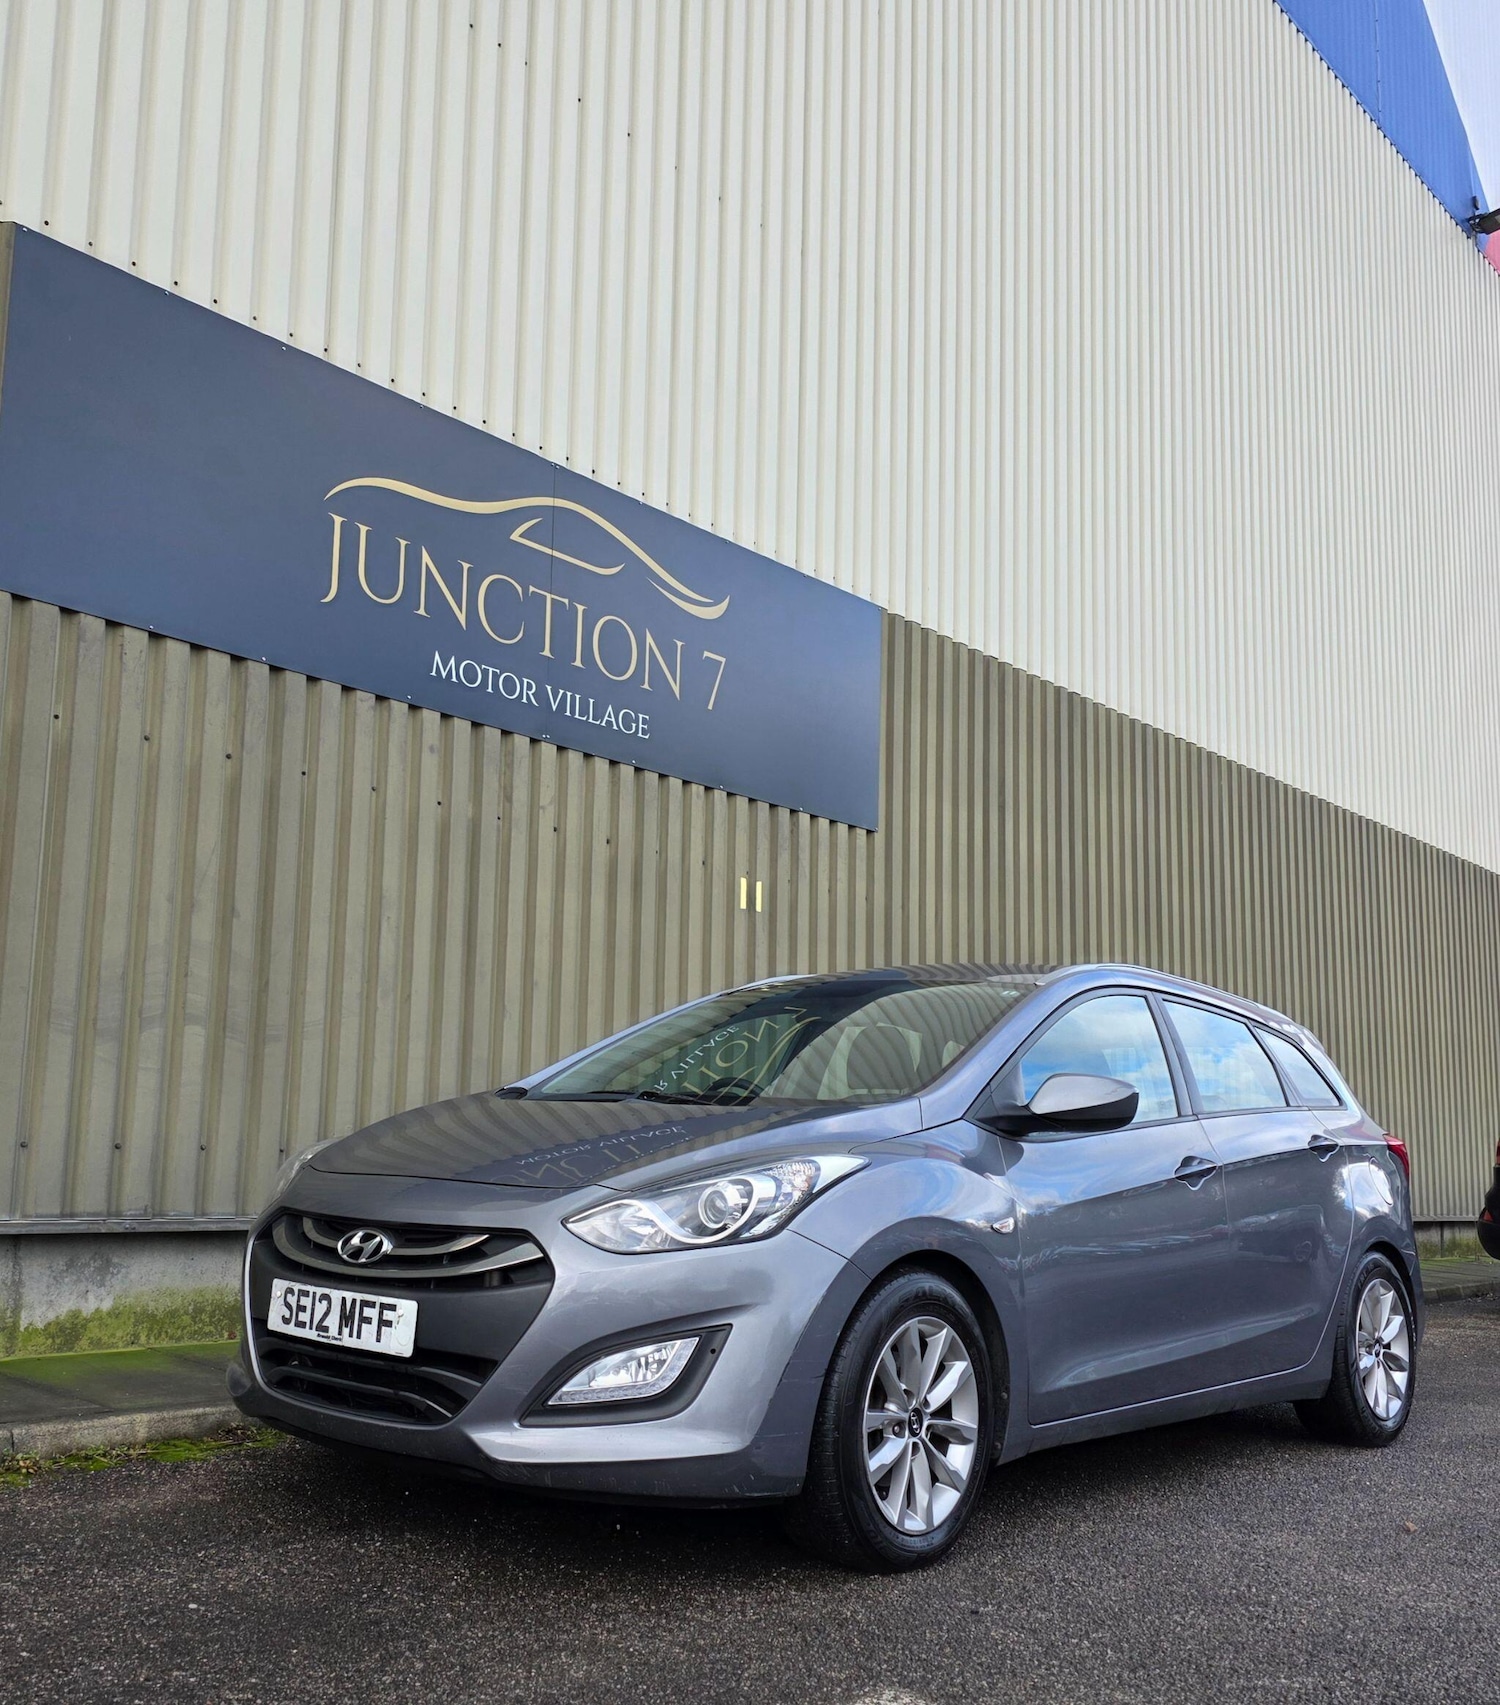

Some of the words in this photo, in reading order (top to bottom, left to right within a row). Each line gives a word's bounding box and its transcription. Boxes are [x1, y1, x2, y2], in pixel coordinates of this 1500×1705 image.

[320, 511, 686, 701] JUNCTION
[701, 650, 728, 711] 7
[429, 650, 540, 708] MOTOR
[545, 684, 651, 739] VILLAGE
[281, 1286, 333, 1332] SE12
[338, 1296, 397, 1343] MFF
